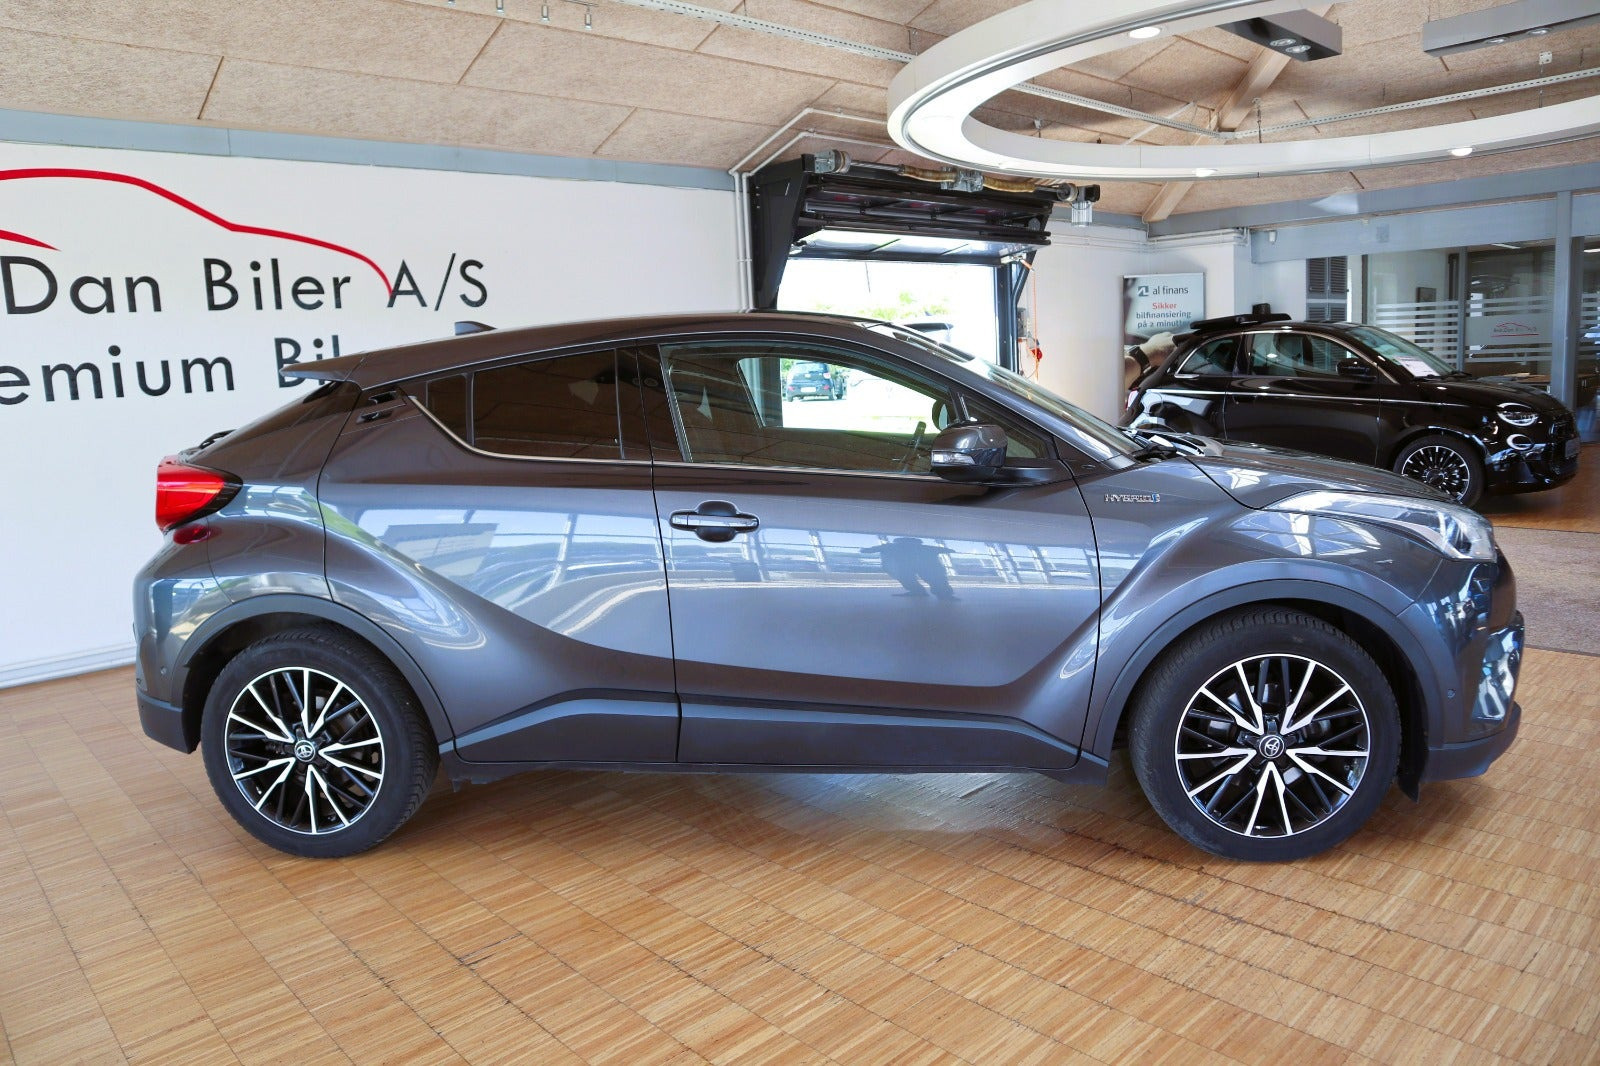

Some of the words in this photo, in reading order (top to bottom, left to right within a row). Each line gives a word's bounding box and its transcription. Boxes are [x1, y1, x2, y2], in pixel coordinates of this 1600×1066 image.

[203, 257, 351, 311] Biler
[387, 252, 488, 311] A/S
[1152, 285, 1160, 295] al
[1162, 285, 1189, 295] finans
[1152, 302, 1177, 310] Sikker
[1136, 310, 1192, 319] bilfinansiering
[1137, 320, 1147, 329] på
[1104, 493, 1153, 503] HYBRID
